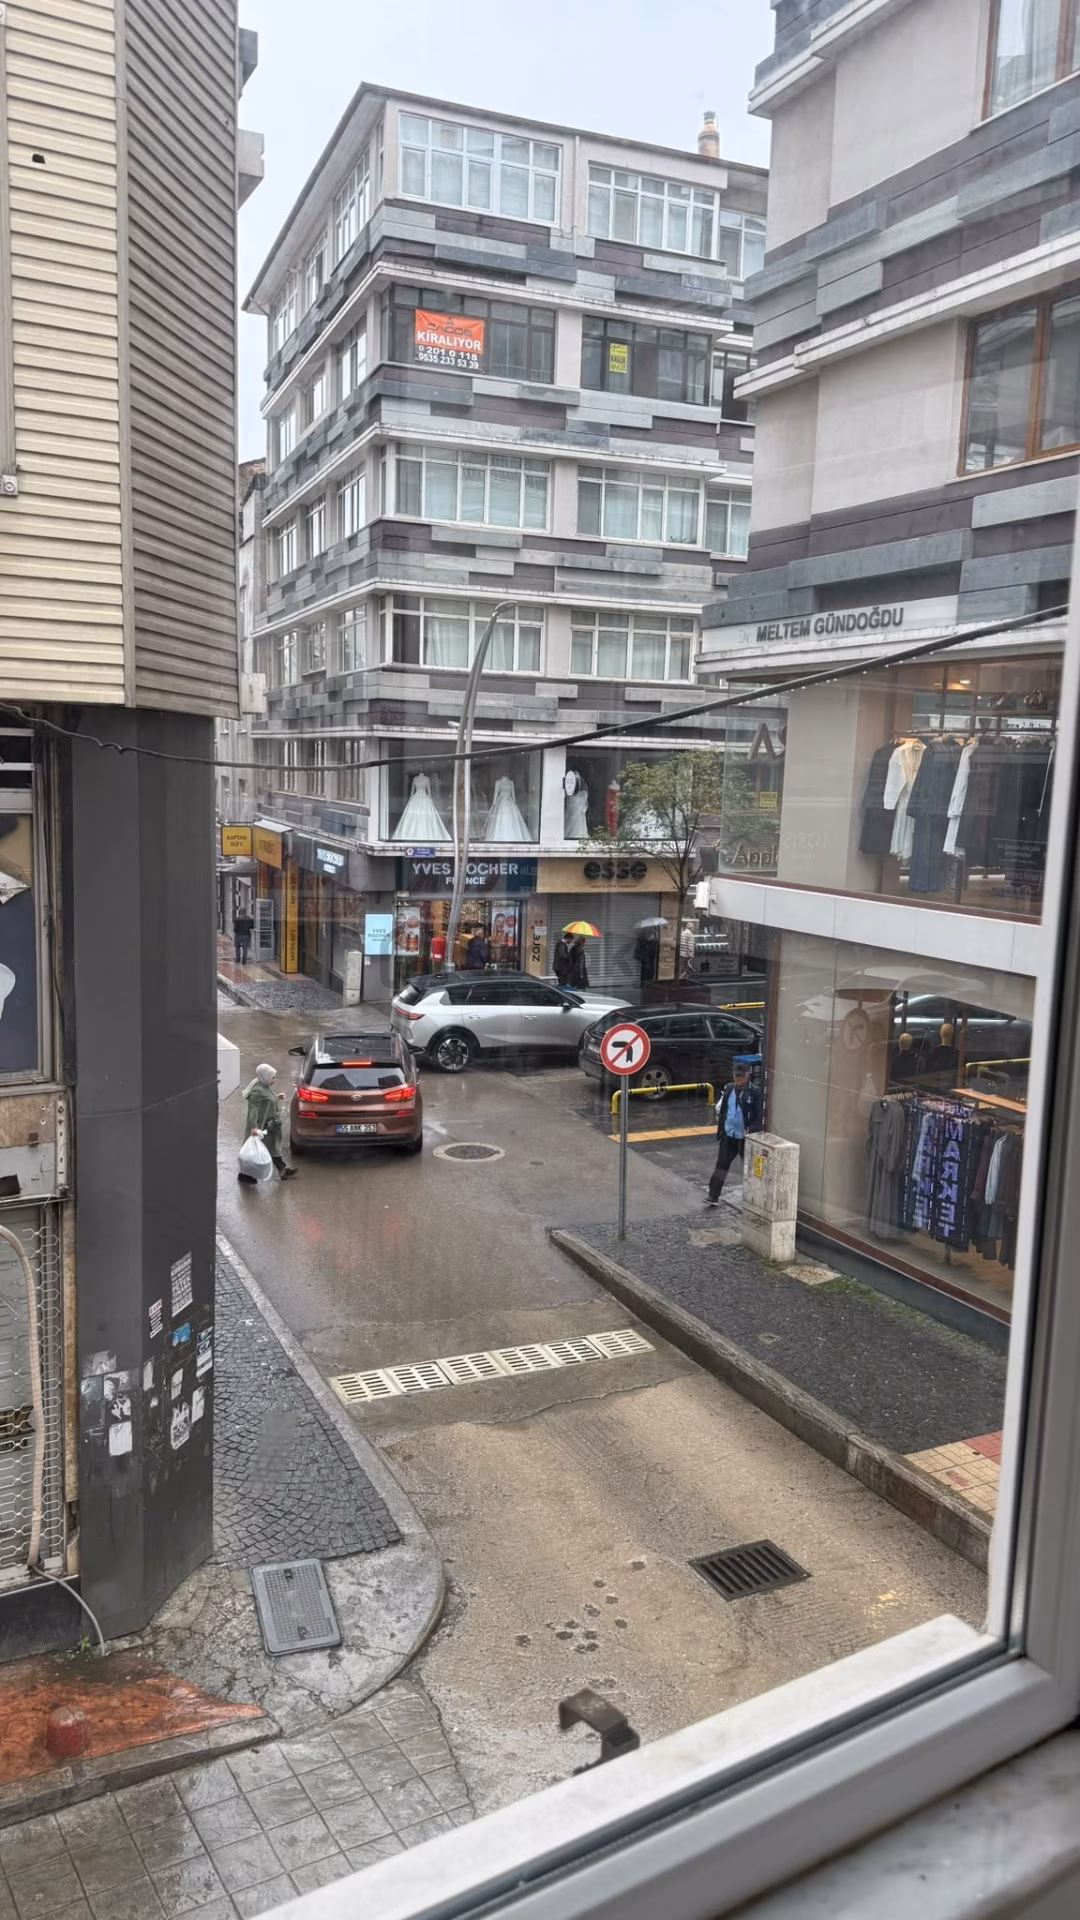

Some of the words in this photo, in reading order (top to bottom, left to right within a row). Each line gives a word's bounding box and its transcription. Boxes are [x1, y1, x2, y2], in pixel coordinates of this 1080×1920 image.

[417, 330, 481, 351] KİRALIYOR
[418, 353, 438, 363] 0535
[468, 361, 479, 369] 39
[426, 346, 445, 355] 201
[459, 352, 478, 361] 118
[756, 619, 811, 643] MELTEM
[813, 606, 904, 636] GÜNDOĞDU
[412, 862, 451, 875] YVES
[464, 862, 519, 875] OCHER
